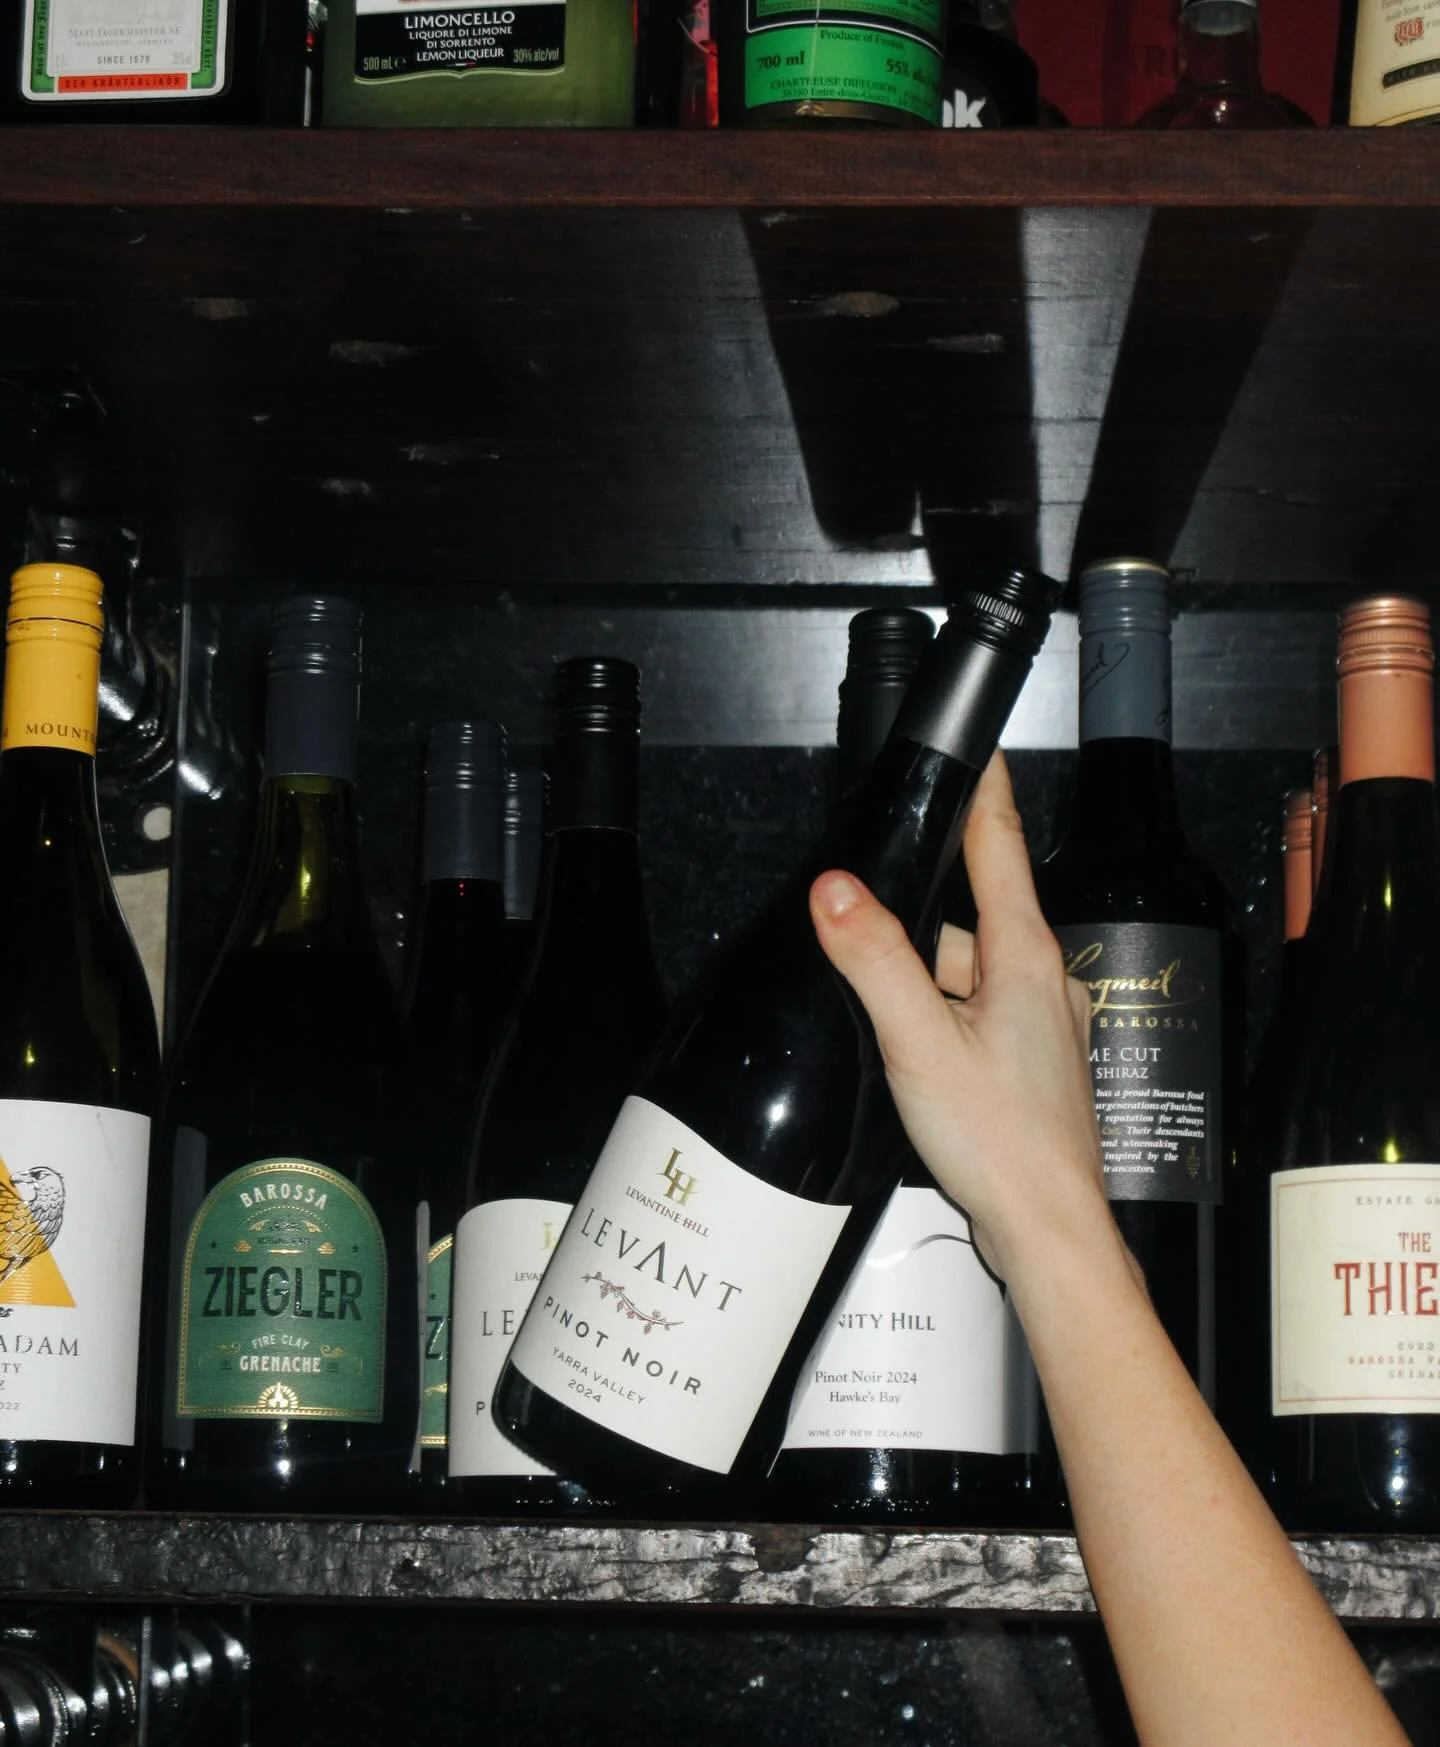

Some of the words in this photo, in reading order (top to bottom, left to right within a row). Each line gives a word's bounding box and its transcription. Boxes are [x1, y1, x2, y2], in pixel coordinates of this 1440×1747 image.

[404, 10, 516, 29] LIMONCELLO
[409, 30, 455, 40] LIQUORE
[458, 29, 469, 37] DI
[472, 26, 513, 36] LIMONE
[820, 29, 862, 41] Produce
[863, 33, 874, 43] of
[426, 41, 438, 49] DI
[440, 37, 496, 48] SORRENTO
[97, 55, 125, 65] SINCE
[417, 51, 456, 62] LEMON
[458, 48, 505, 60] LIQUEUR
[513, 48, 532, 63] 30%
[756, 55, 782, 72] 700
[785, 50, 805, 66] ml
[363, 57, 379, 71] 500
[65, 79, 86, 89] DER
[1100, 1015, 1198, 1031] BAROSSA
[1120, 1048, 1162, 1062] CUT
[1096, 1066, 1149, 1080] SHIRAZ
[1096, 1088, 1112, 1097] has
[1122, 1089, 1151, 1099] proud
[1152, 1089, 1186, 1099] Barossa
[1105, 1102, 1160, 1112] generations
[1160, 1102, 1170, 1112] of
[1171, 1102, 1204, 1113] butchers
[1105, 1115, 1154, 1125] reputation
[1159, 1115, 1172, 1125] for
[1126, 1126, 1151, 1135] Their
[1155, 1127, 1205, 1138] descendants
[1122, 1139, 1179, 1151] winemaking
[1105, 1151, 1141, 1162] inspired
[1148, 1152, 1160, 1162] by
[1164, 1152, 1179, 1161] the
[1112, 1164, 1156, 1173] ancestors.
[240, 1183, 327, 1211] BAROSSA
[1356, 1196, 1413, 1206] ESTATE
[625, 1185, 683, 1223] LEVANTINE
[682, 1216, 711, 1239] HILL
[1397, 1231, 1432, 1253] THE
[580, 1207, 743, 1313] LEVANT
[515, 1271, 545, 1282] LEVA
[202, 1266, 363, 1321] ZIEGLER
[1333, 1262, 1439, 1316] THIE
[481, 1309, 518, 1336] LE
[891, 1312, 936, 1331] HILL
[251, 1334, 277, 1350] FIRE
[282, 1334, 311, 1350] CLAY
[543, 1295, 609, 1348] PINOT
[621, 1346, 703, 1395] NOIR
[239, 1355, 322, 1373] GRENACHE
[551, 1345, 589, 1377] YARRA
[593, 1371, 648, 1405] VALLEY
[815, 1370, 848, 1384] Pinot
[852, 1370, 882, 1384] Noir
[887, 1371, 918, 1385] 2024
[567, 1378, 602, 1403] 2024
[829, 1391, 875, 1403] Hawke's
[879, 1391, 901, 1405] Bay
[807, 1428, 831, 1438] WINE
[834, 1429, 846, 1438] OF
[850, 1429, 874, 1438] NEW
[877, 1429, 923, 1440] ZEALAND
